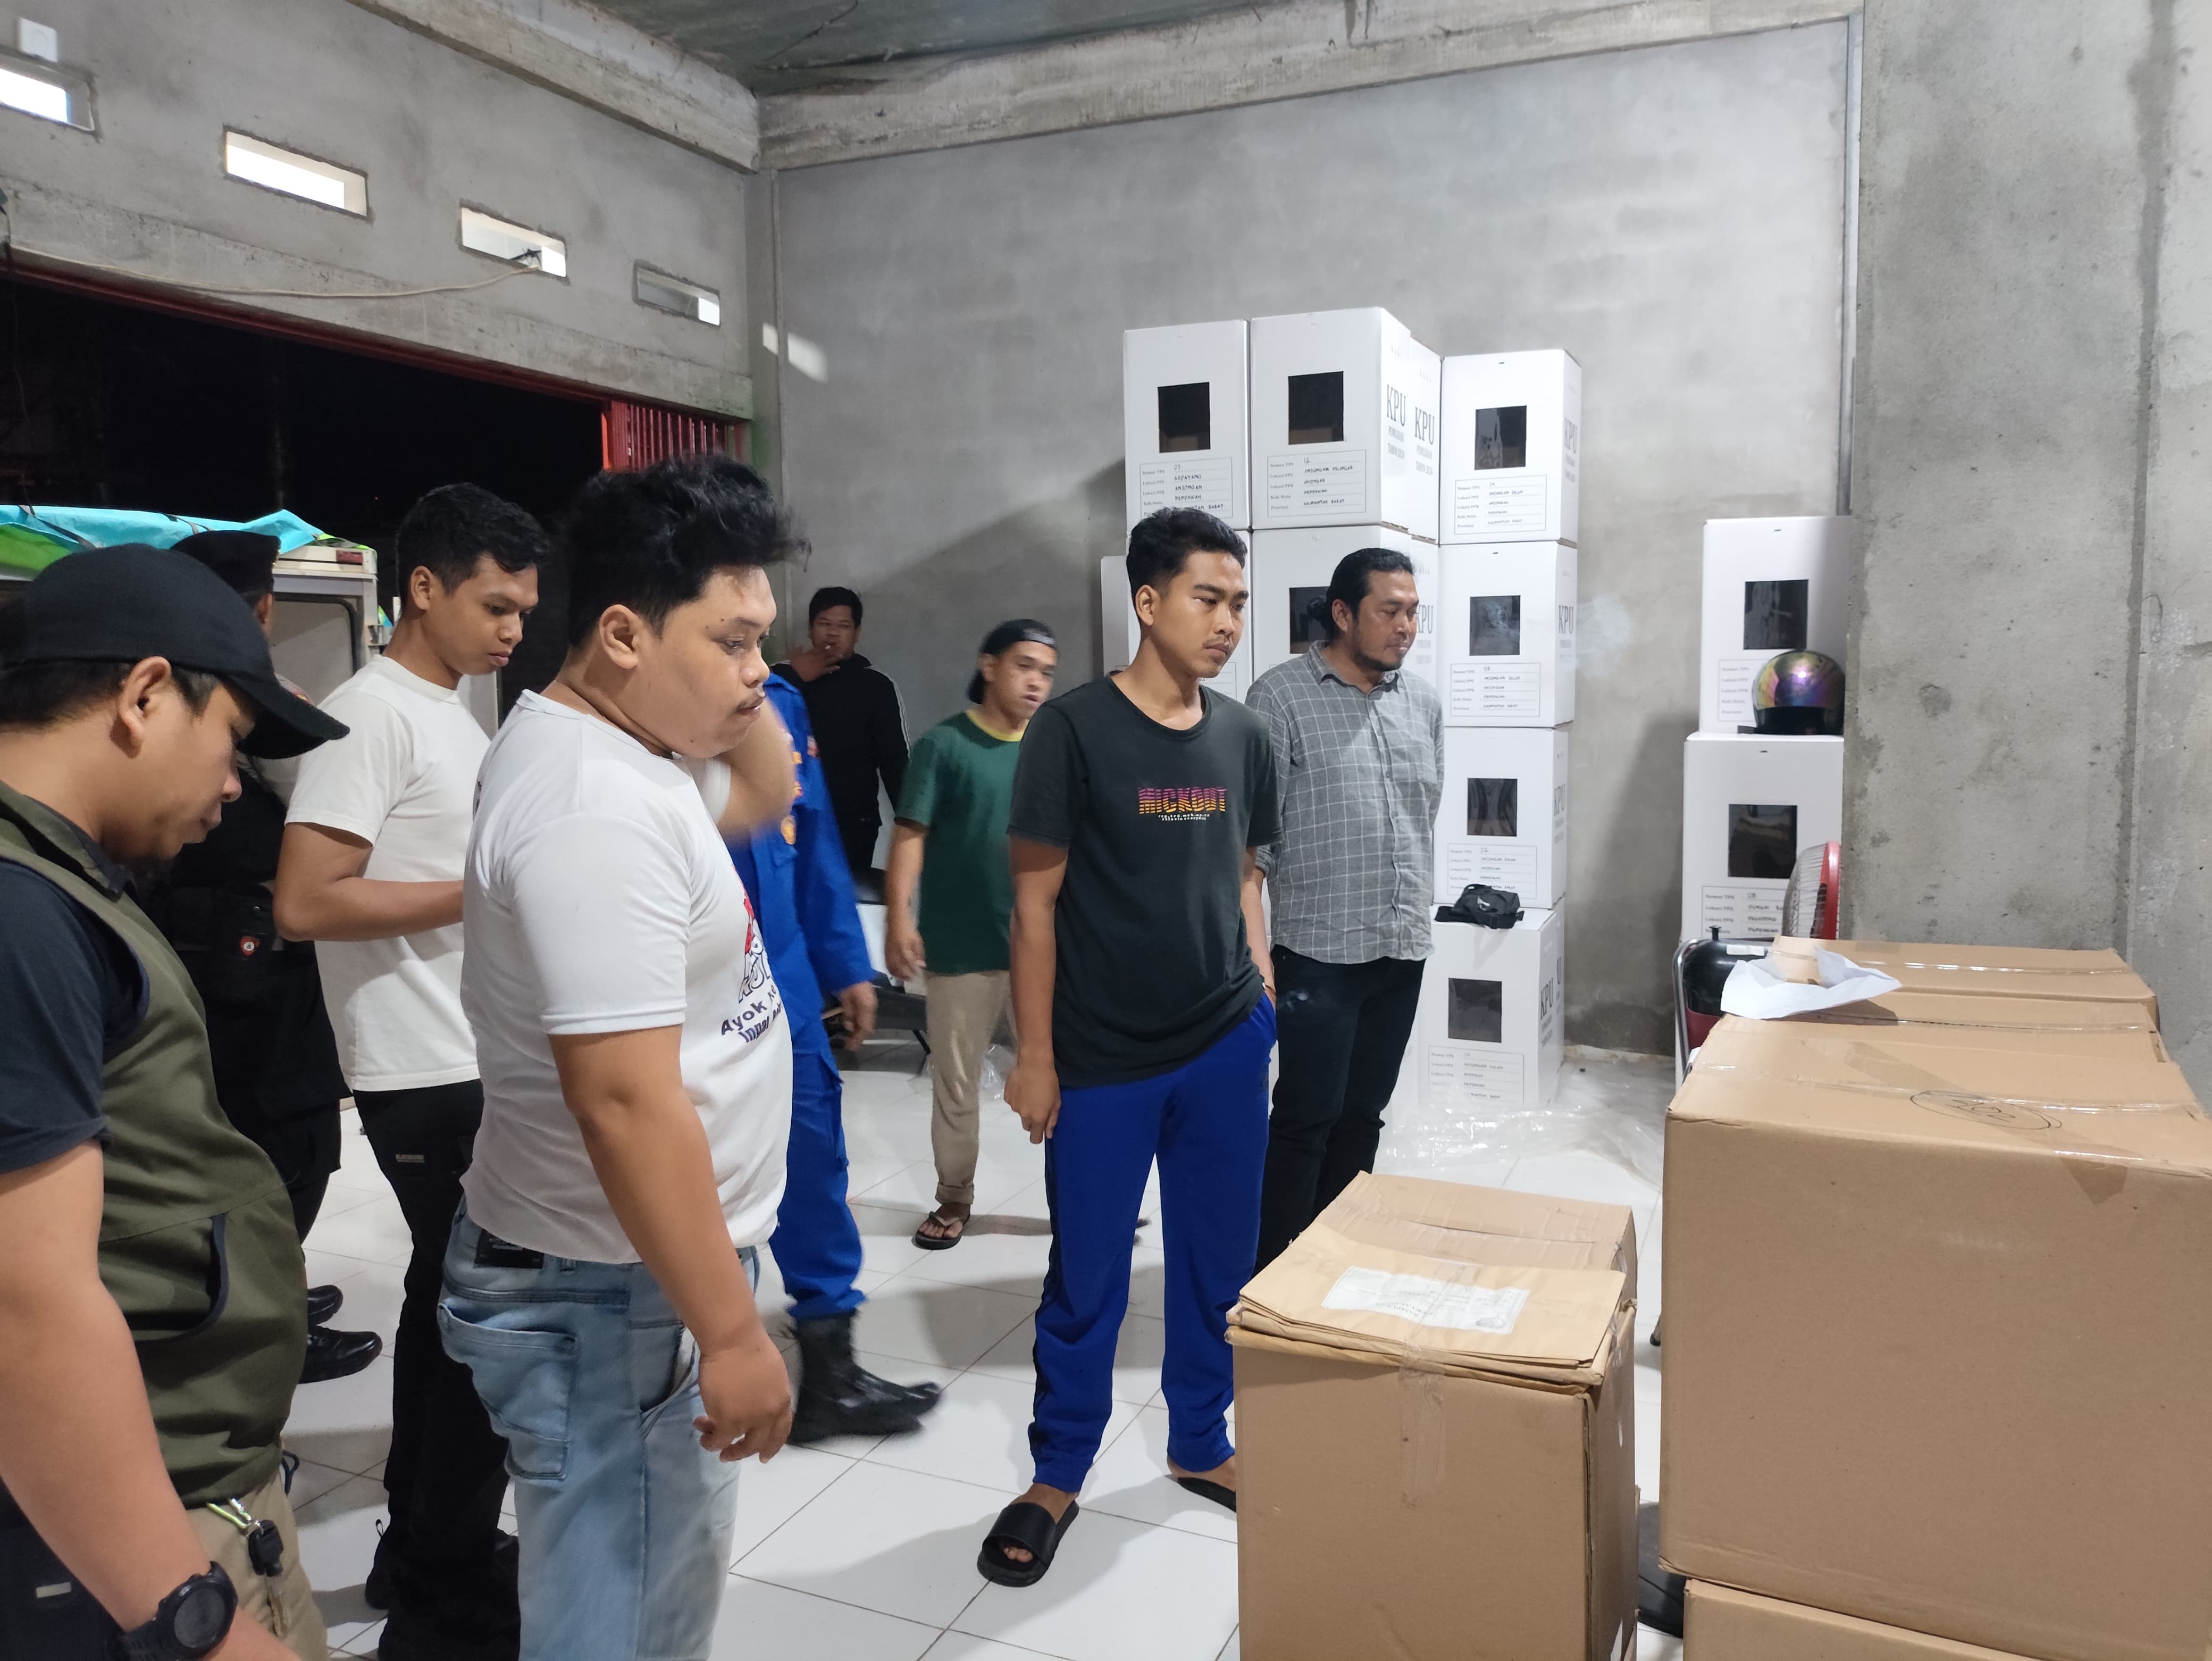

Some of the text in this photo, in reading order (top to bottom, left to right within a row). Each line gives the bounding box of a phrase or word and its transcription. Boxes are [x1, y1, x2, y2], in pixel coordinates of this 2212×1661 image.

[1387, 383, 1406, 427] KPU
[1414, 406, 1435, 445] KPU
[1559, 605, 1574, 635] KPU
[722, 1000, 767, 1036] Ayok
[1540, 977, 1554, 1020] KPU
